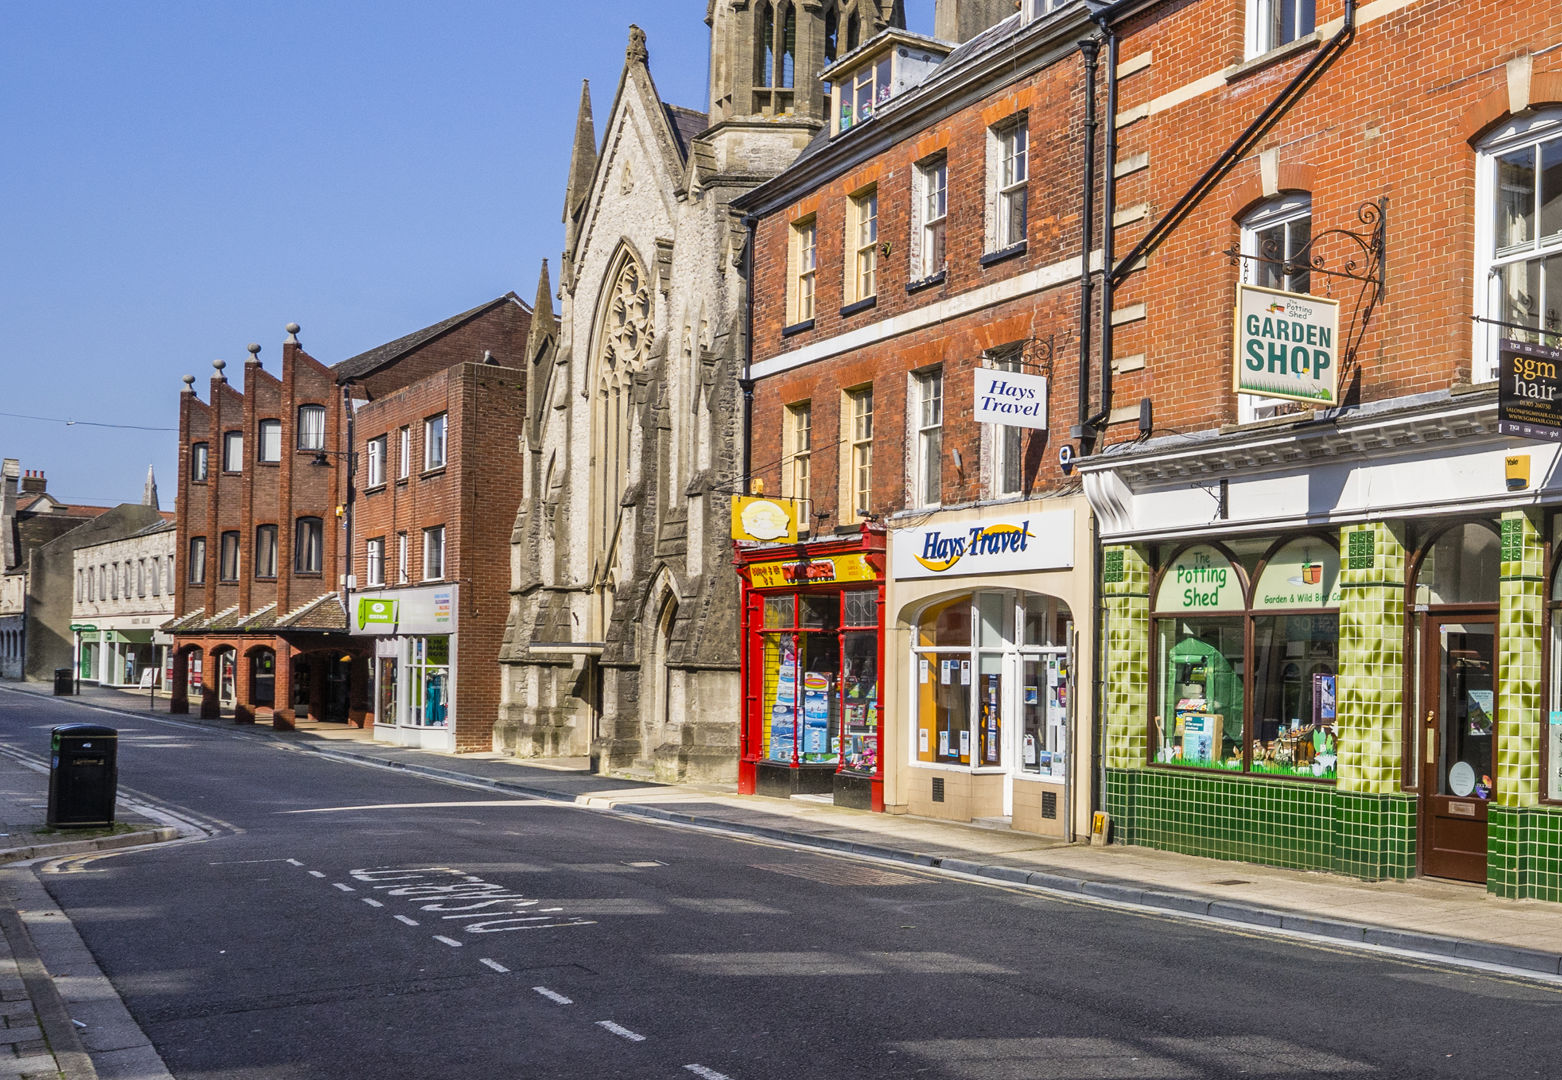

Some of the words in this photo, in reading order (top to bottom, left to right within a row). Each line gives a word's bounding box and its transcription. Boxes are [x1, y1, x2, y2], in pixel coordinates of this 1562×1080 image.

[1286, 303, 1312, 315] Potting
[1288, 311, 1307, 320] Shed
[1246, 314, 1331, 348] GARDEN
[1246, 339, 1331, 380] SHOP
[1513, 357, 1557, 380] sgm
[989, 380, 1036, 401] Hays
[1513, 374, 1556, 401] hair
[981, 396, 1040, 417] Travel
[1507, 458, 1519, 466] Yale
[922, 531, 966, 565] Hays
[969, 520, 1030, 556] Travel
[1193, 552, 1210, 563] The
[1177, 565, 1227, 588] Potting
[1183, 587, 1219, 607] Shed
[1264, 594, 1288, 604] Garden
[1297, 593, 1312, 602] Wild
[1315, 592, 1329, 602] Bird
